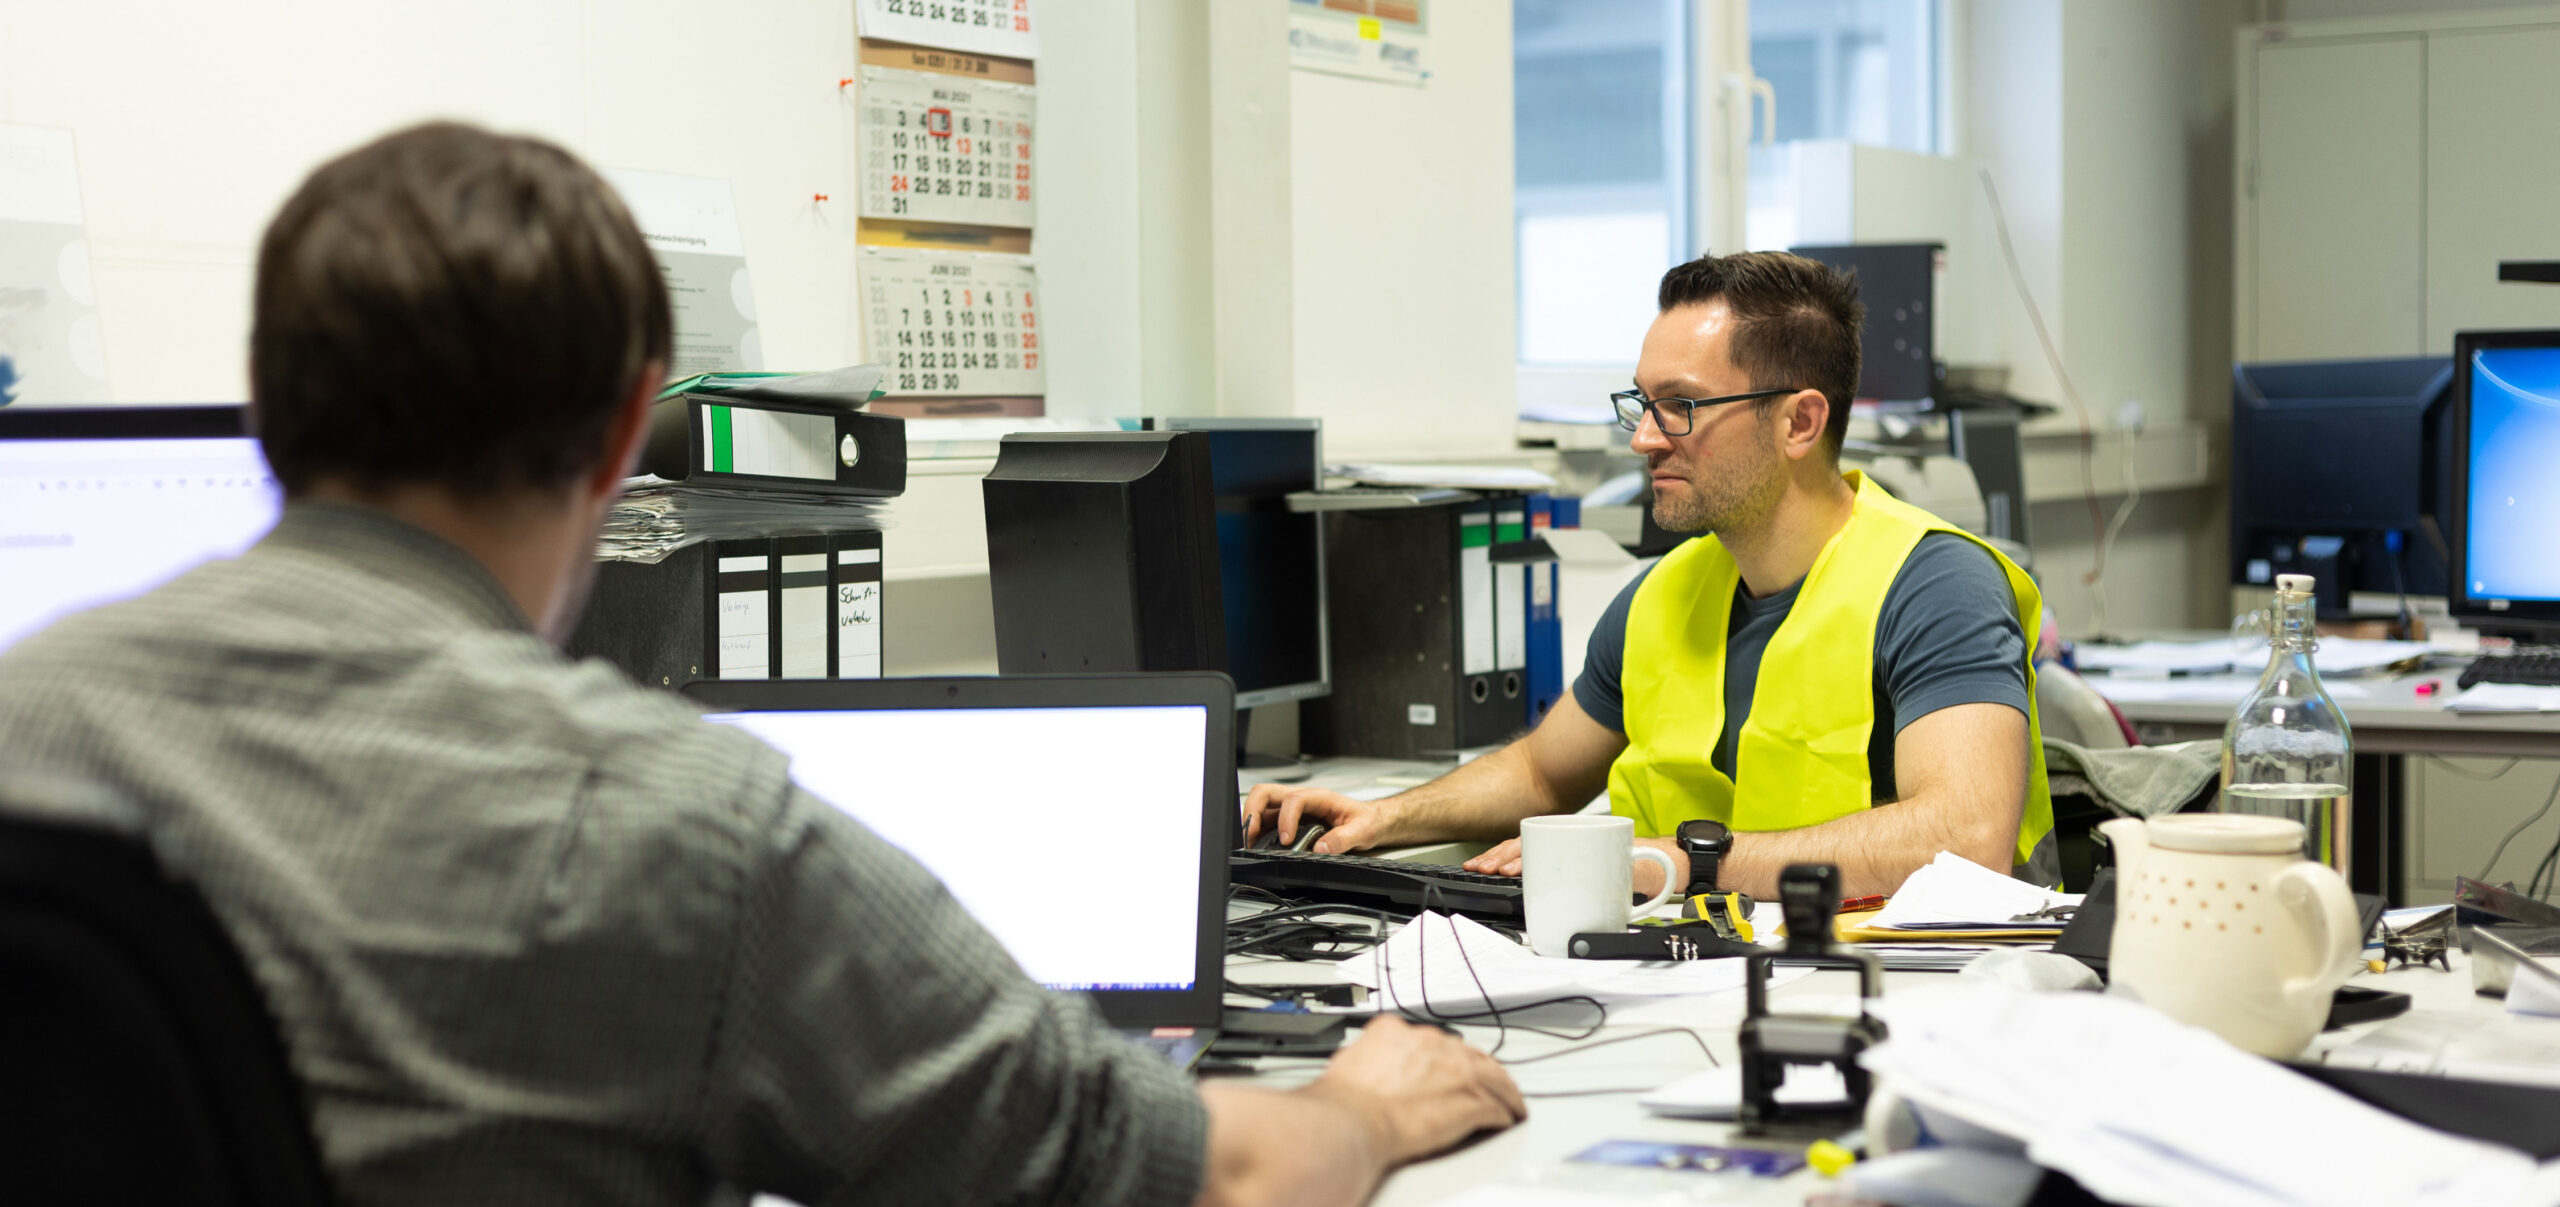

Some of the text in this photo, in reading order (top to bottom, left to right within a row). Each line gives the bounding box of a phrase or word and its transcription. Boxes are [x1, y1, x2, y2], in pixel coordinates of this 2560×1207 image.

[888, 0, 903, 14] 22
[910, 0, 924, 18] 23
[930, 4, 945, 20] 24
[952, 6, 967, 24] 25
[973, 10, 988, 26] 26
[1014, 16, 1030, 32] 28
[950, 90, 972, 103] 2021
[898, 111, 906, 127] 3
[920, 113, 928, 128] 4
[940, 114, 950, 131] 5
[962, 117, 970, 133] 6
[983, 119, 991, 134] 7
[892, 132, 908, 148] 10
[915, 136, 928, 150] 11
[936, 137, 950, 152] 12
[957, 138, 971, 154] 13
[978, 141, 992, 156] 14
[892, 154, 908, 170] 17
[916, 156, 930, 172] 18
[936, 158, 950, 174] 19
[956, 159, 972, 175] 20
[978, 161, 991, 176] 21
[997, 162, 1011, 178] 22
[1016, 164, 1030, 181] 23
[891, 175, 908, 192] 24
[915, 177, 930, 194] 25
[936, 178, 951, 195] 26
[958, 180, 972, 196] 27
[978, 182, 992, 198] 28
[997, 184, 1011, 200] 29
[1016, 185, 1030, 201] 30
[892, 198, 908, 214] 31
[930, 264, 972, 276] JUNI 2021
[922, 288, 928, 304] 1
[943, 289, 951, 305] 2
[964, 290, 972, 306] 3
[985, 291, 993, 305] 4
[902, 308, 910, 324] 7
[924, 310, 932, 326] 8
[945, 310, 954, 326] 9
[960, 311, 974, 326] 10
[982, 312, 994, 326] 11
[1002, 312, 1016, 328] 12
[1022, 312, 1035, 328] 13
[898, 331, 912, 346] 14
[920, 332, 934, 347] 15
[942, 332, 955, 348] 16
[962, 332, 976, 348] 17
[984, 333, 997, 348] 18
[1004, 333, 1018, 348] 19
[1022, 333, 1038, 349] 20
[898, 353, 912, 368] 21
[920, 353, 936, 368] 22
[942, 353, 957, 368] 23
[962, 353, 978, 369] 24
[984, 353, 998, 369] 25
[1004, 353, 1019, 369] 26
[1024, 353, 1038, 370] 27
[900, 374, 959, 390] 28 29 30
